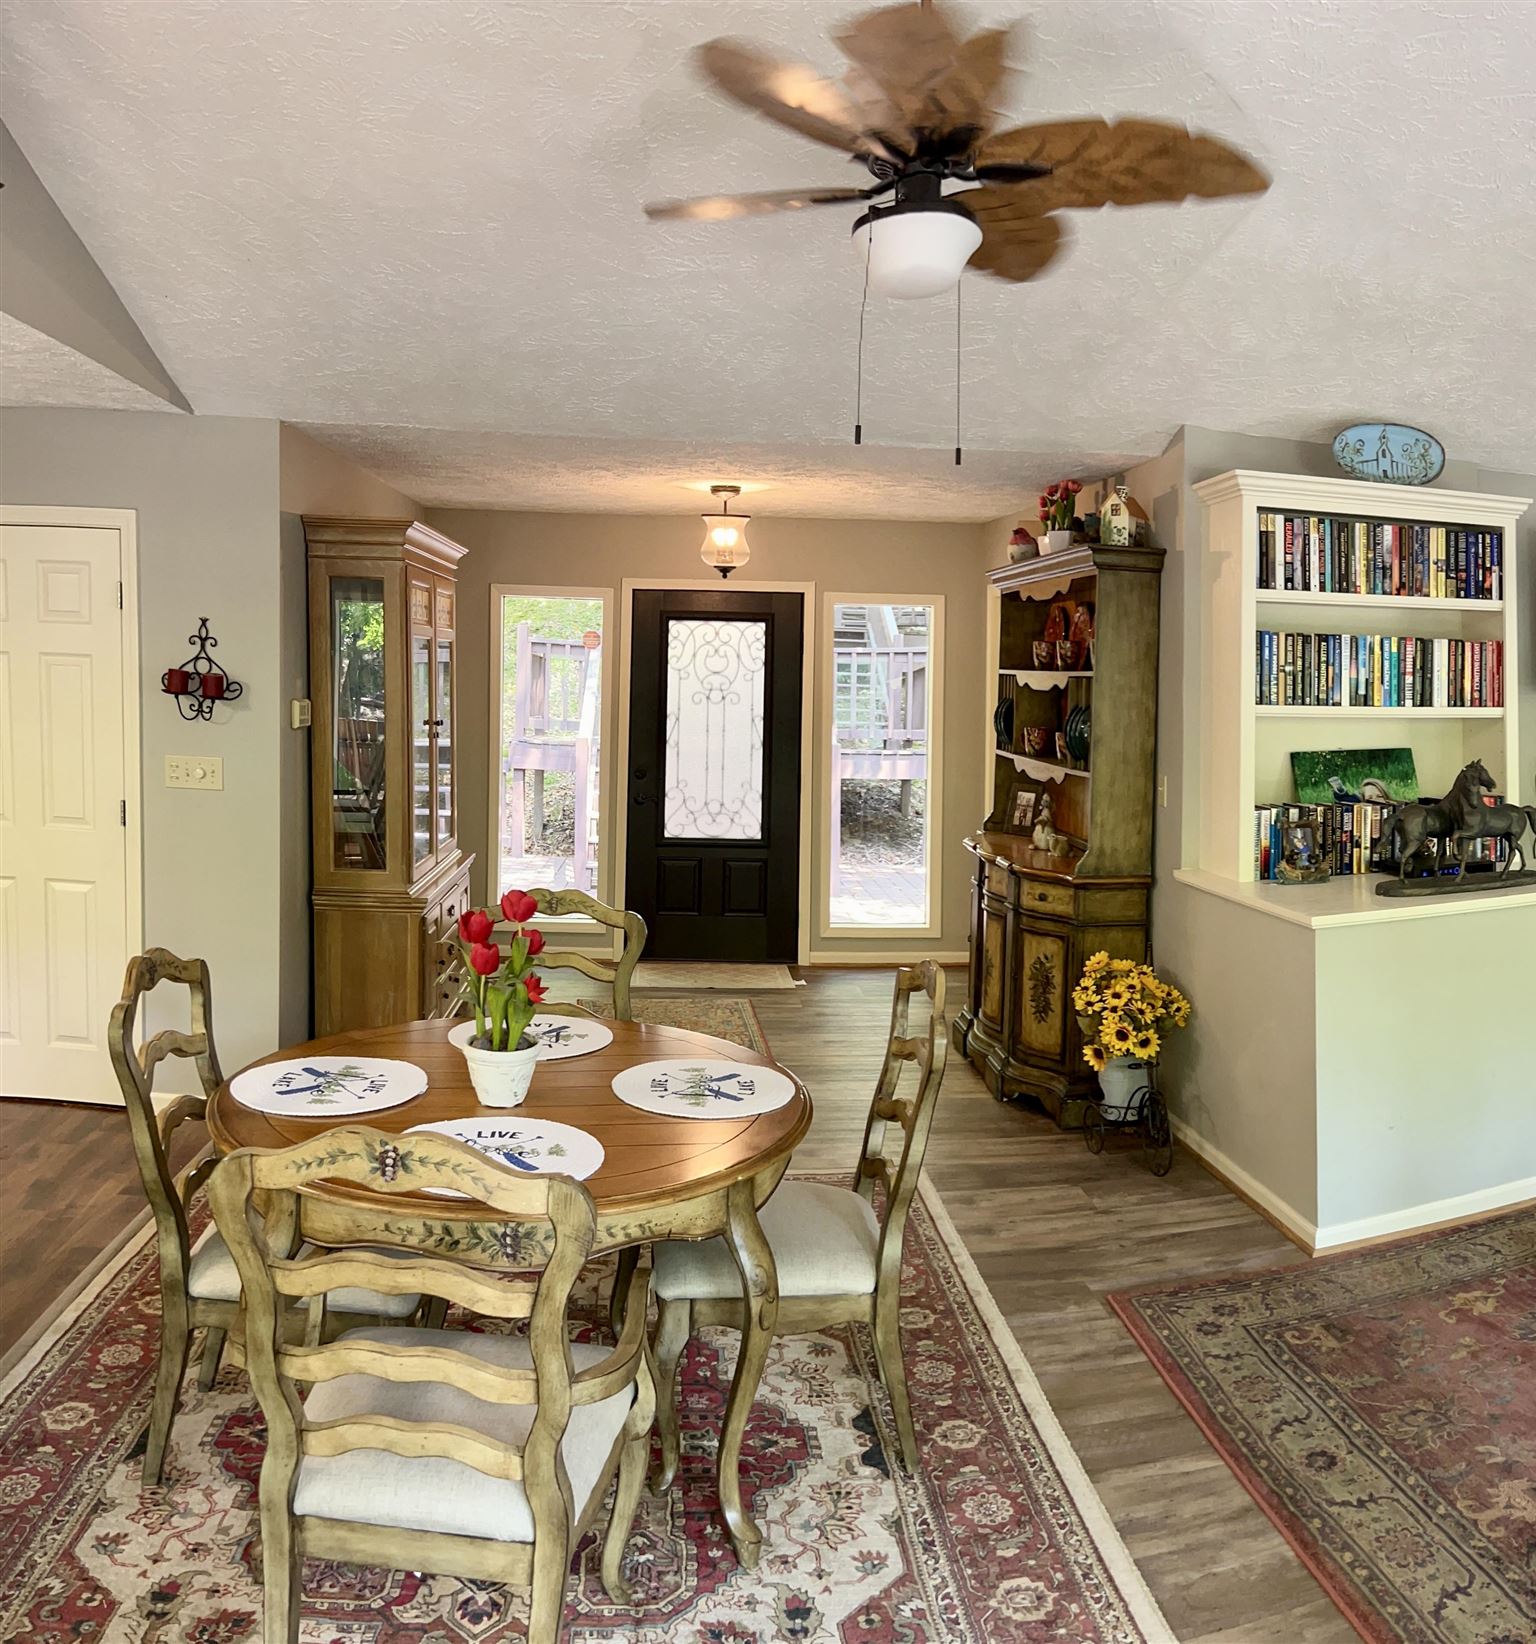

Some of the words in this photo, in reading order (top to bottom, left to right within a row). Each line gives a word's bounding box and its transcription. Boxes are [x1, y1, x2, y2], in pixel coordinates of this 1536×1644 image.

[1320, 641, 1328, 662] KILLER
[1473, 643, 1481, 662] DAVID
[1320, 663, 1328, 690] INSTINCT
[1473, 661, 1481, 690] BALDACCI
[271, 1071, 303, 1088] LAKE
[361, 1079, 389, 1095] LIVE
[650, 1078, 669, 1092] LIVE
[736, 1079, 756, 1096] LAKE
[476, 1130, 525, 1140] LIVE
